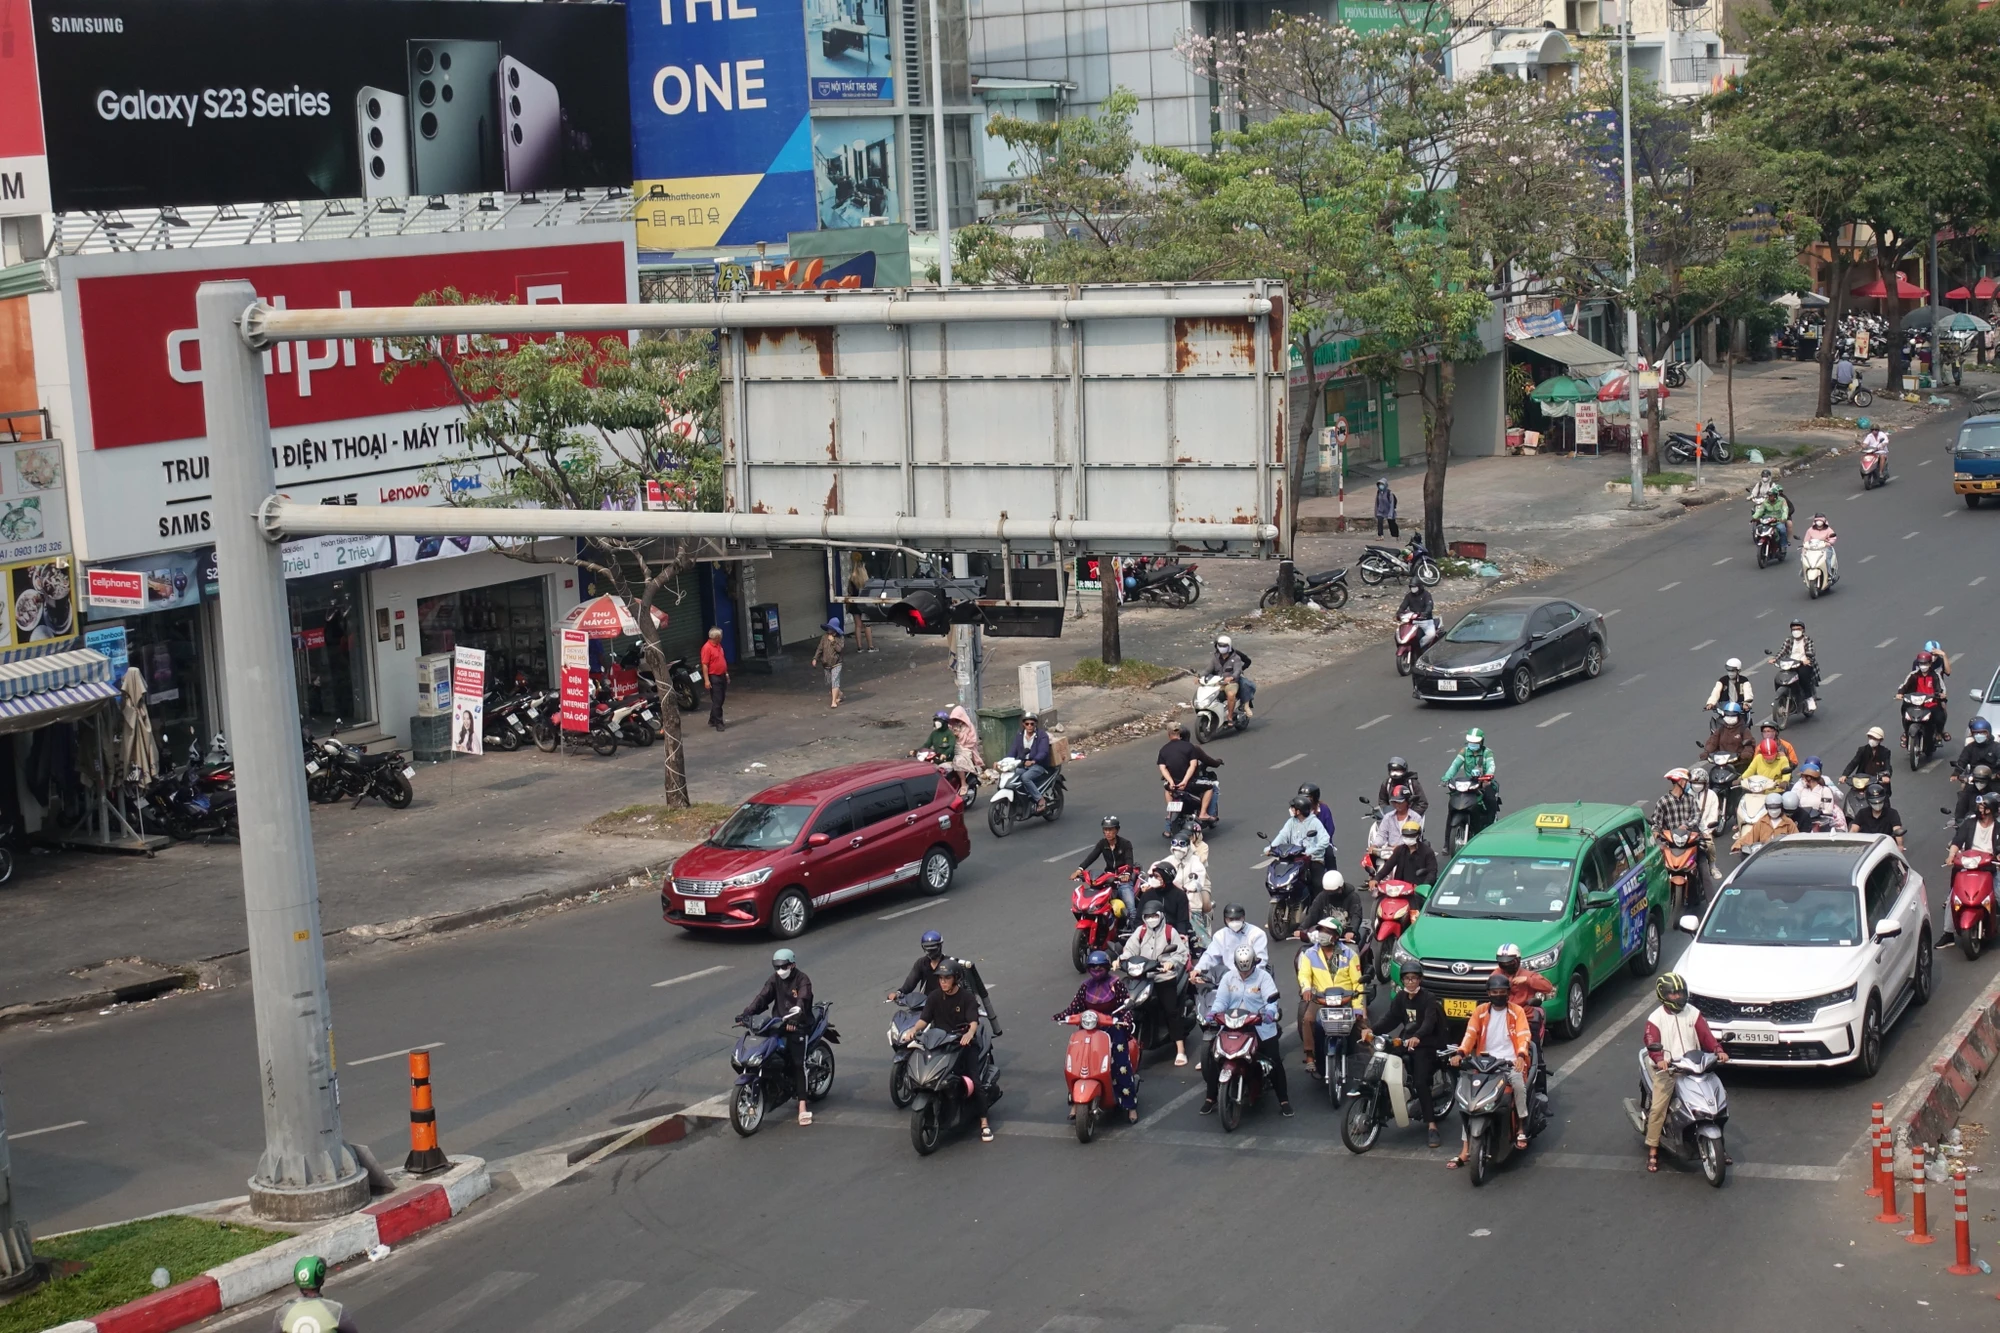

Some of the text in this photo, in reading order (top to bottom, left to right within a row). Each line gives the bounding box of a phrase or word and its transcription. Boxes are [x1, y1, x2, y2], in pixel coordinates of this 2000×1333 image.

[51, 17, 124, 33] SAMSUNG
[652, 59, 767, 115] ONE
[97, 85, 331, 127] Galaxy S23 Series
[0, 172, 25, 200] M
[283, 439, 327, 469] ĐIỆN
[332, 433, 387, 460] THOẠI
[403, 422, 440, 451] MÁY
[379, 484, 430, 503] Lenovo
[336, 546, 375, 565] 2 Triệu
[583, 616, 603, 627] MÁY
[563, 699, 589, 710] INTERNET
[563, 710, 588, 722] TRẢ GÓP
[1453, 1000, 1468, 1009] 51G
